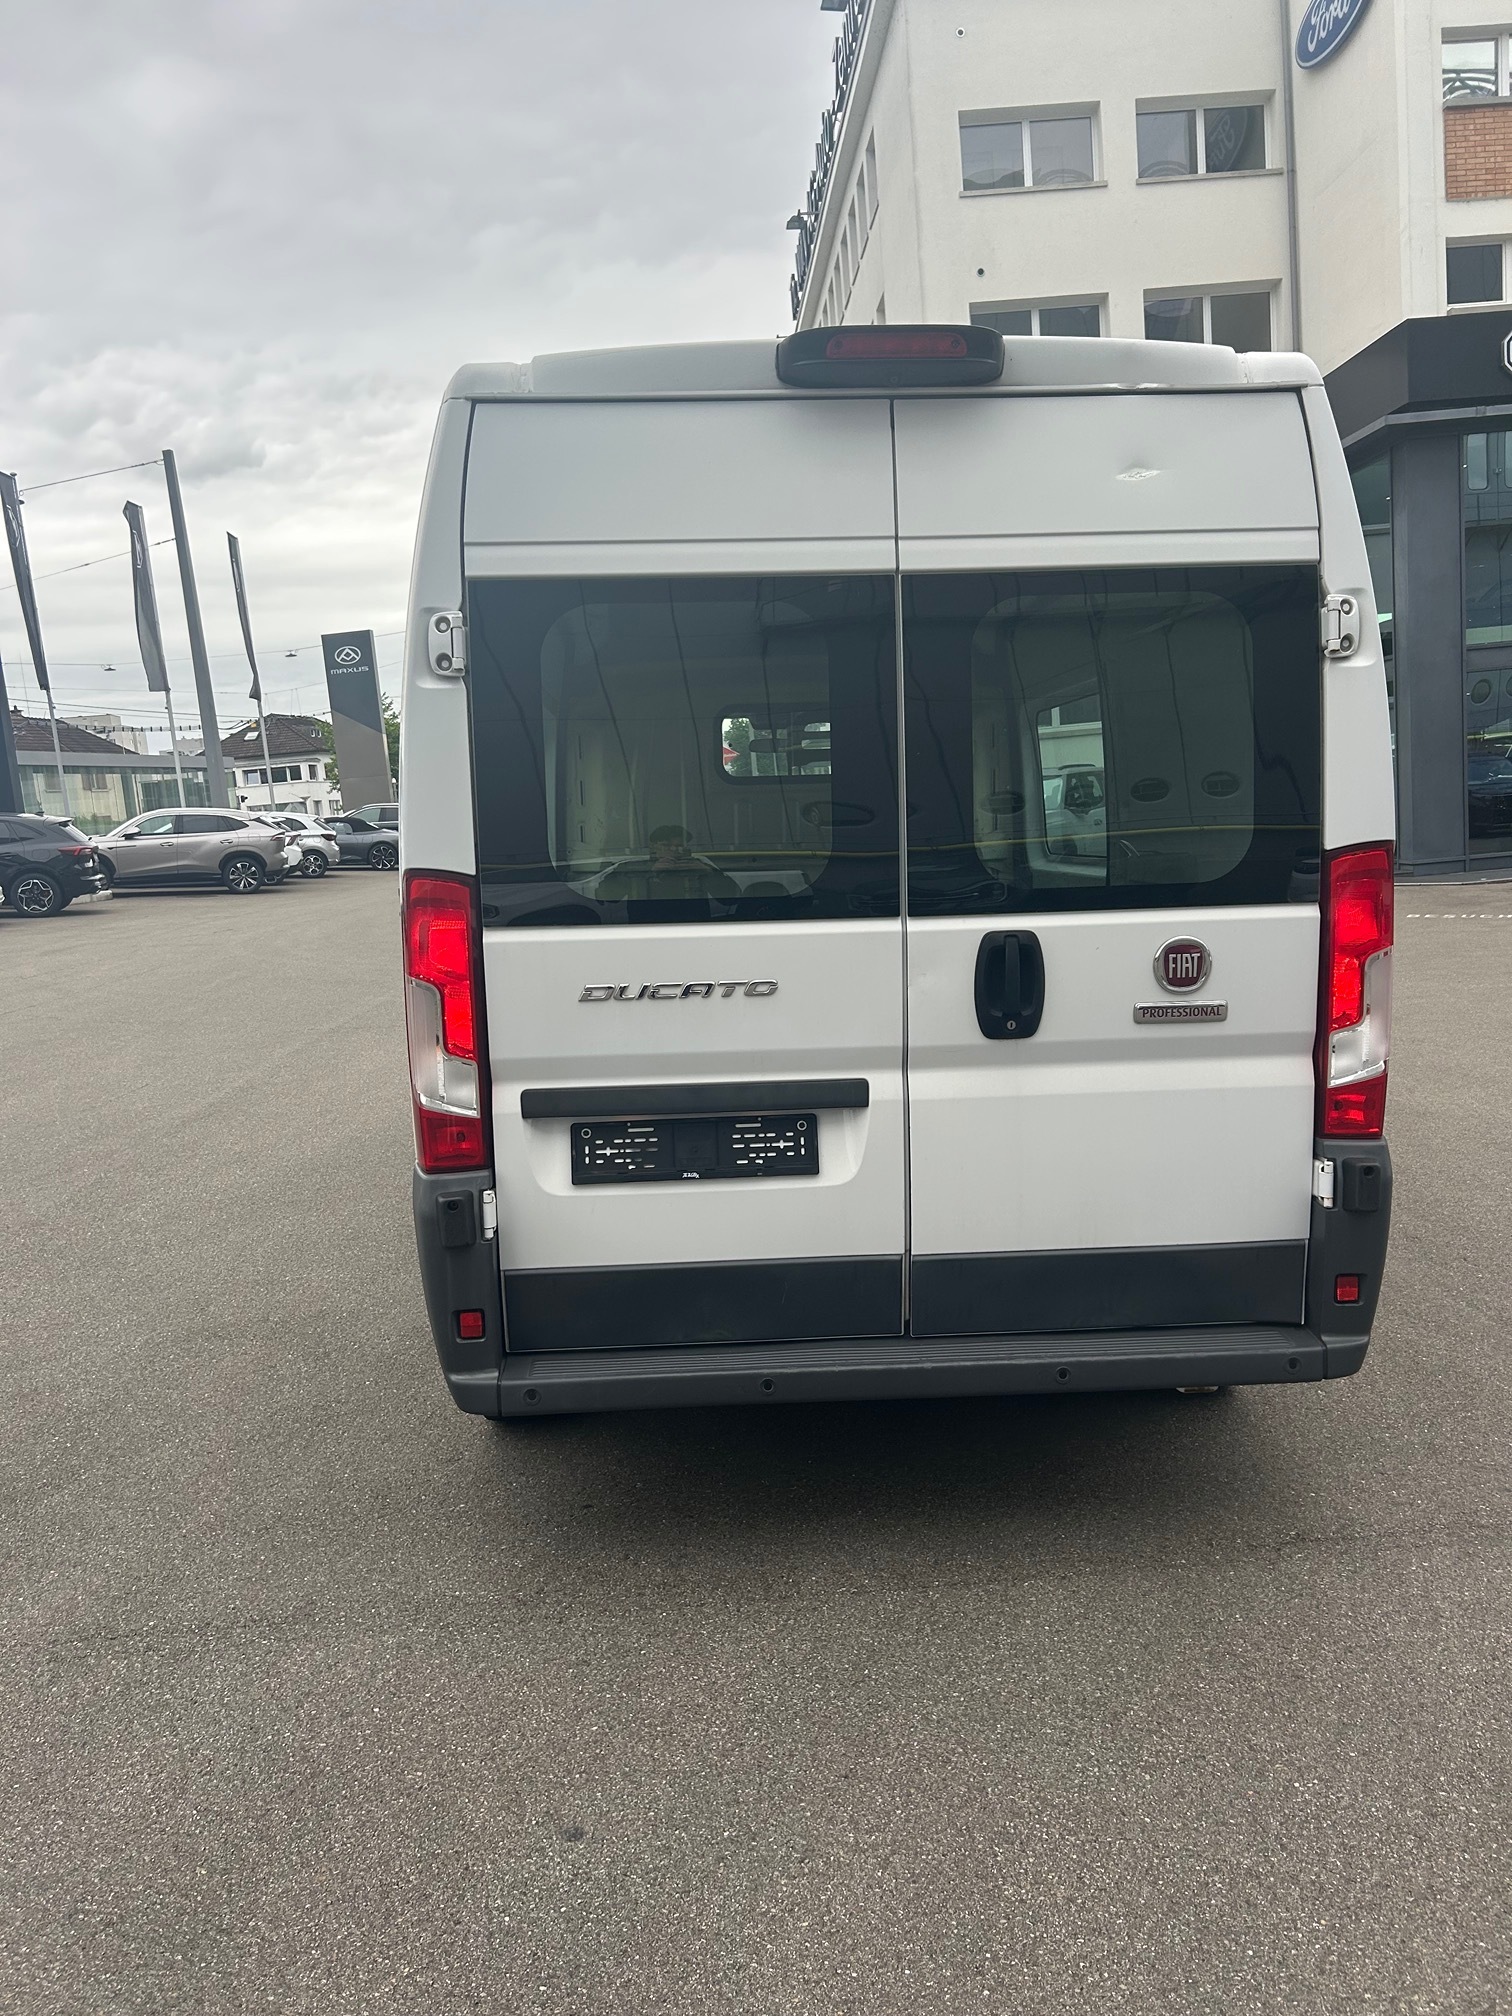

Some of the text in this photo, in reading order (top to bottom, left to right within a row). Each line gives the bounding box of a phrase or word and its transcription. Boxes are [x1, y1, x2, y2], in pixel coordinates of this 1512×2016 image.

[330, 665, 369, 675] MAXUS
[1168, 953, 1201, 979] FIAT
[578, 978, 779, 1003] DUCATO
[1142, 1006, 1222, 1019] PROFESSIONAL
